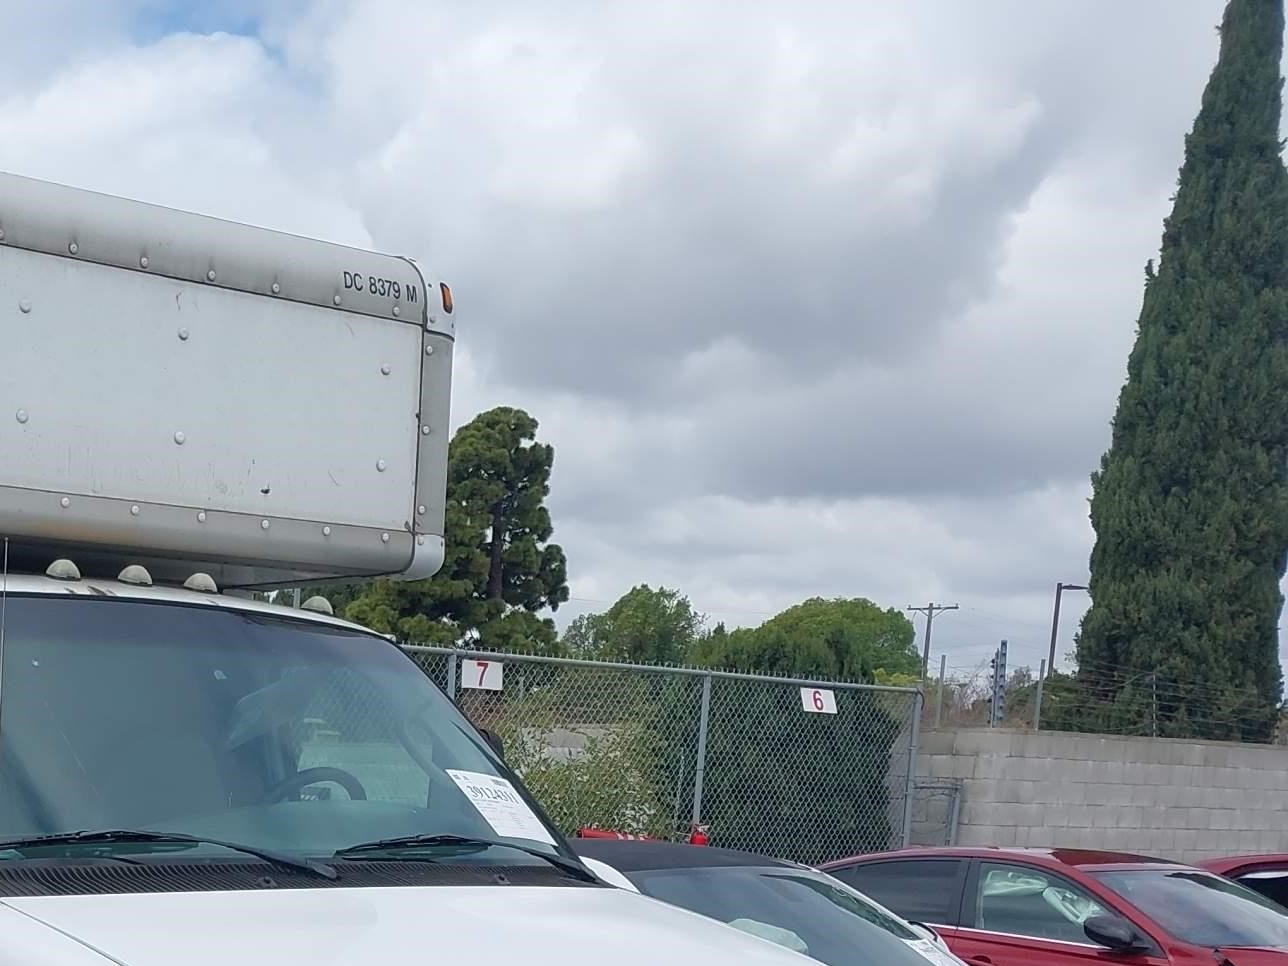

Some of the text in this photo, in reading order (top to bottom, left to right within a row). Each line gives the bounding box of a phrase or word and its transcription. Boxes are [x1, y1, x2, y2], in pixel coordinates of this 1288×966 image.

[343, 271, 418, 304] DC 8379 M
[476, 661, 489, 687] 7
[812, 690, 824, 711] 6
[466, 785, 520, 805] 39124311
